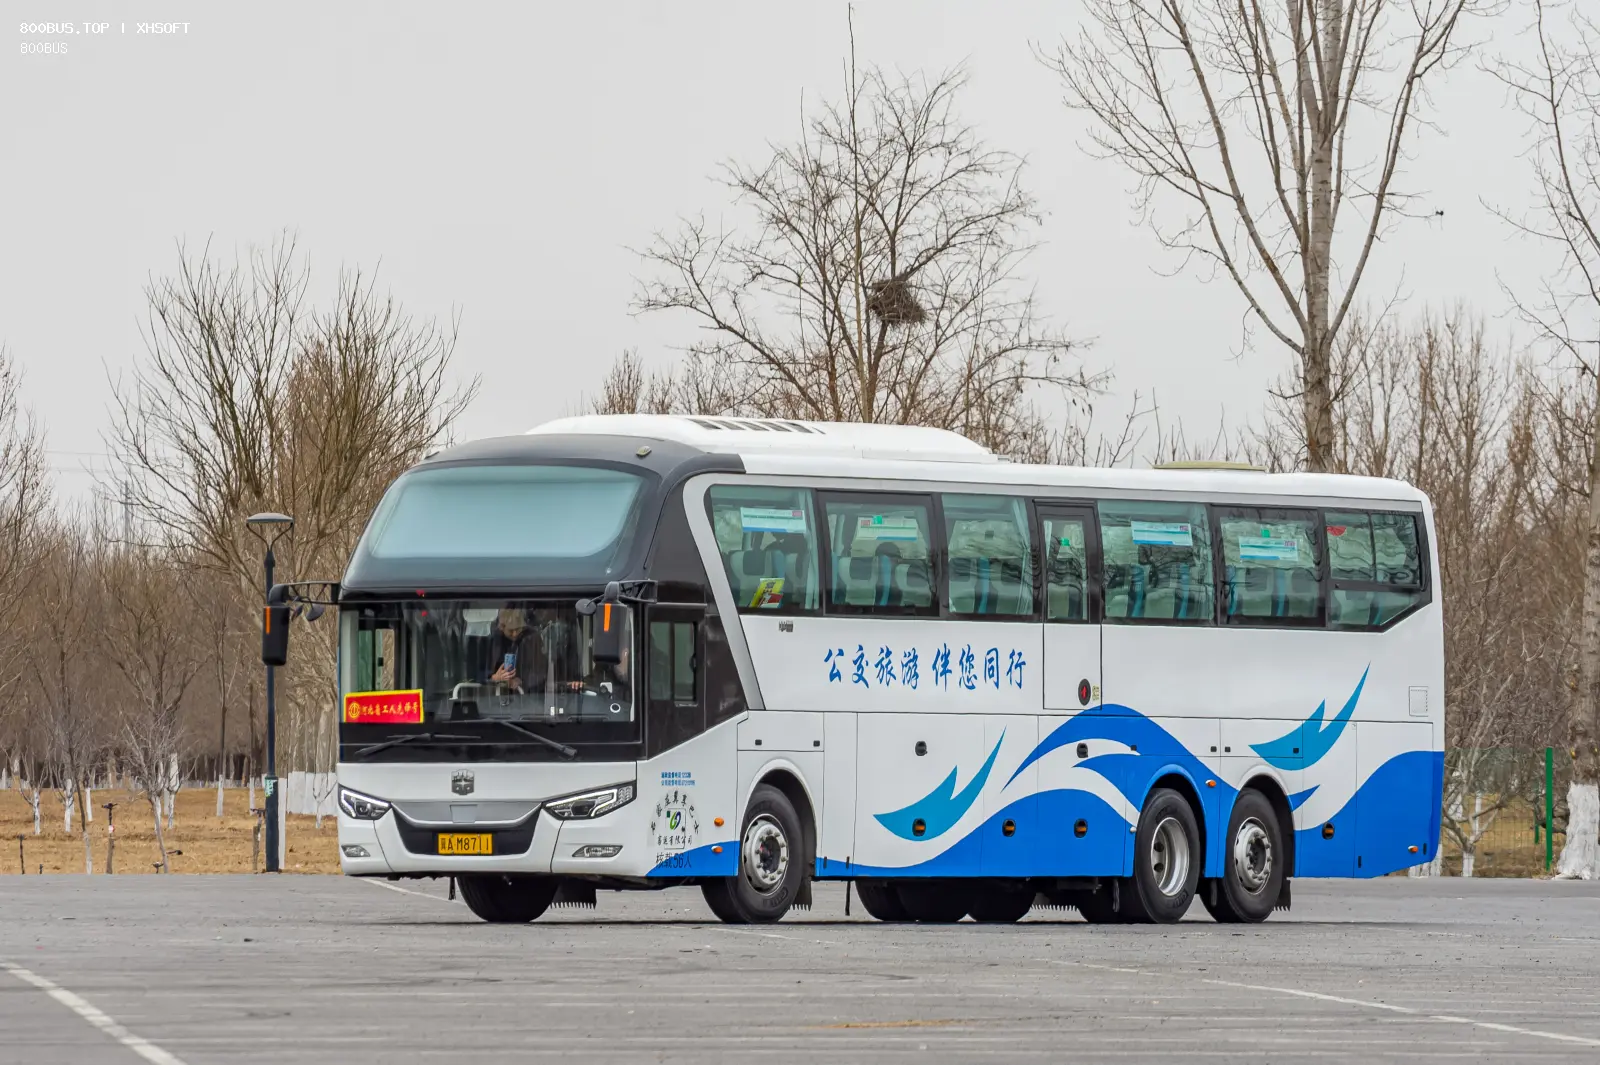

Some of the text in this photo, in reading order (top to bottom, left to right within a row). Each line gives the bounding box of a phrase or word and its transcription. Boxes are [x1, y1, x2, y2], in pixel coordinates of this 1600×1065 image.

[824, 643, 1027, 692] 公交旅游 伴您同行
[655, 852, 692, 869] 核载56人
